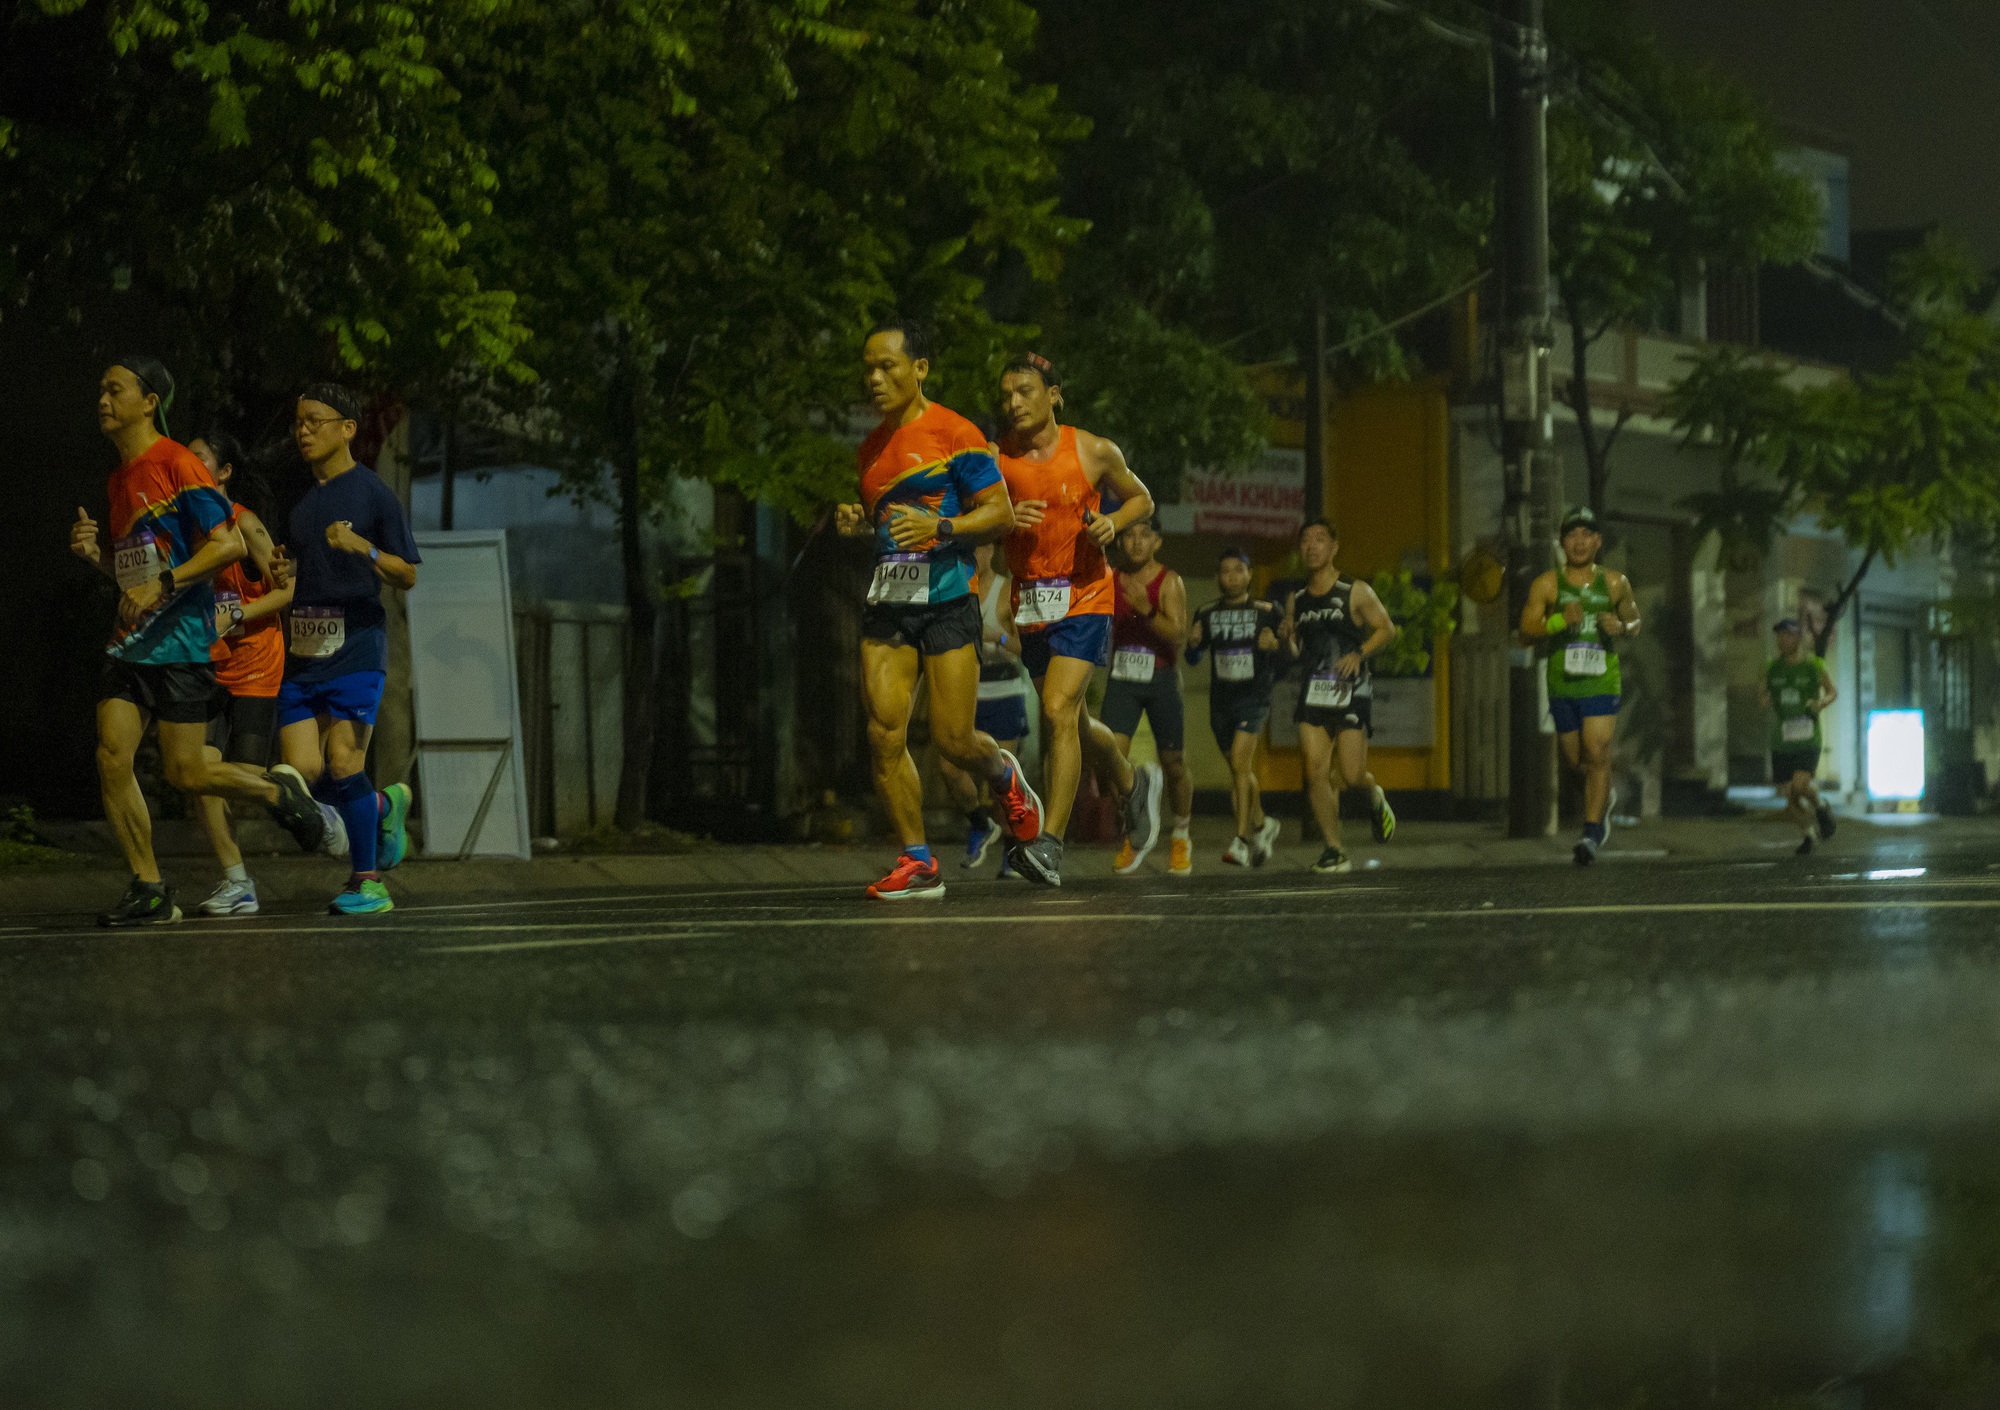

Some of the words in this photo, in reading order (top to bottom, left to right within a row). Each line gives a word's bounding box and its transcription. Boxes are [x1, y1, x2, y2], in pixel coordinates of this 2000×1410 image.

[117, 549, 149, 570] 82102
[1299, 608, 1345, 623] ANTA
[294, 620, 338, 637] 83960
